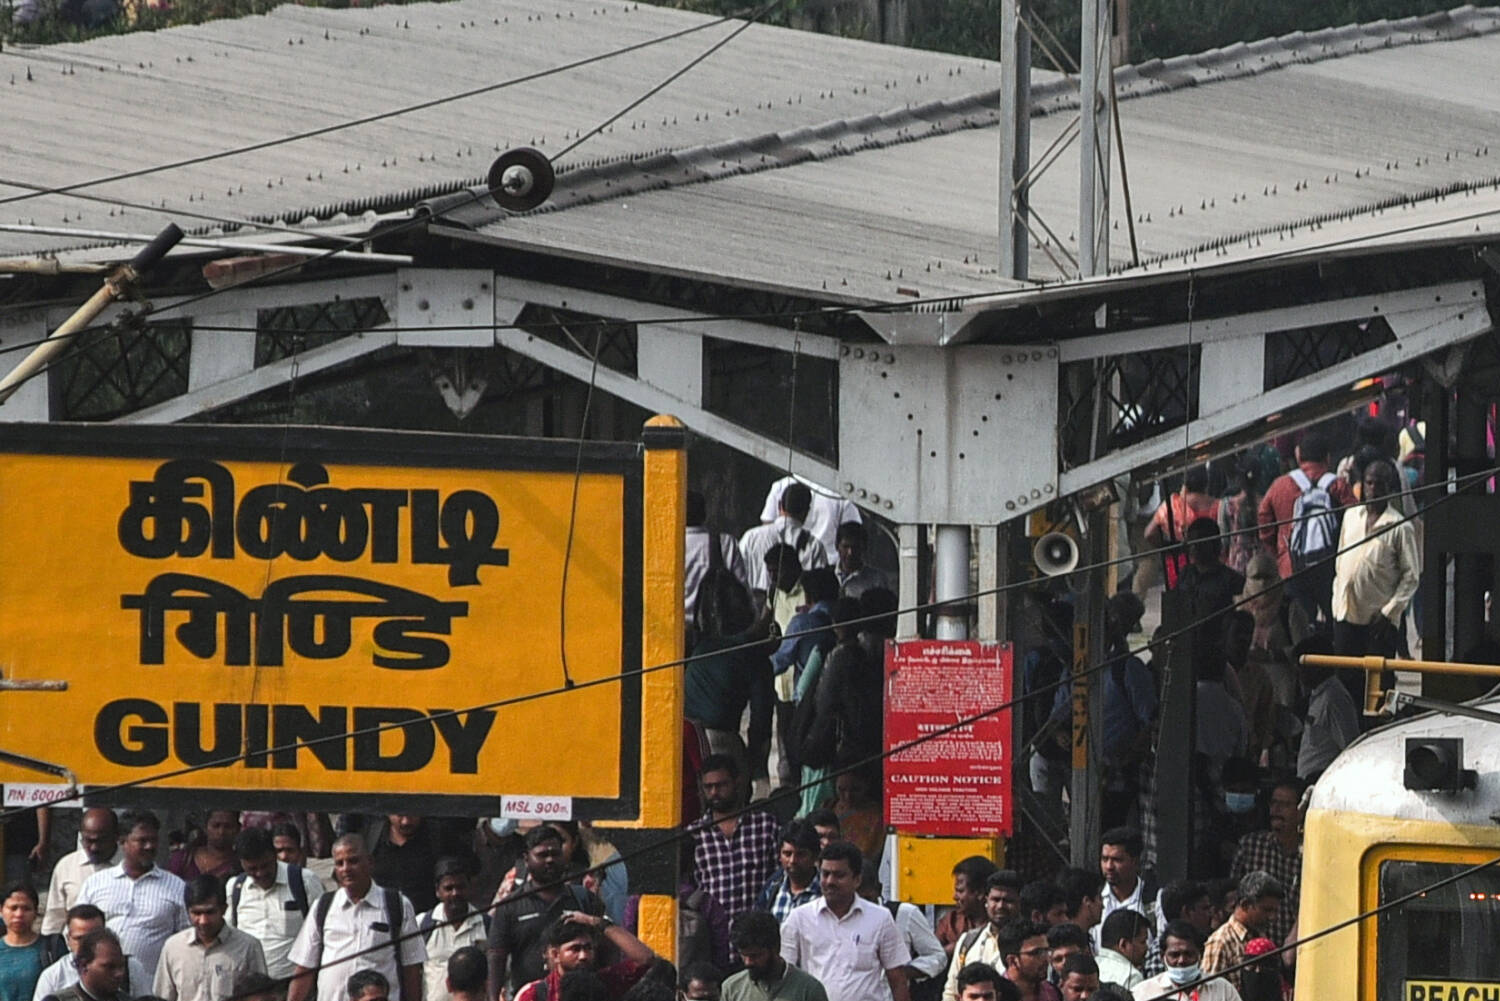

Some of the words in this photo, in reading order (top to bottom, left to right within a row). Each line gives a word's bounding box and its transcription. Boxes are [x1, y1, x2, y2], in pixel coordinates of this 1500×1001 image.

[118, 459, 509, 586] கிண்டி
[121, 573, 469, 670] गिण्डि
[94, 699, 498, 774] GUINDY
[504, 800, 531, 813] MSL
[890, 774, 949, 783] CAUTION
[953, 776, 1002, 784] NOTICE
